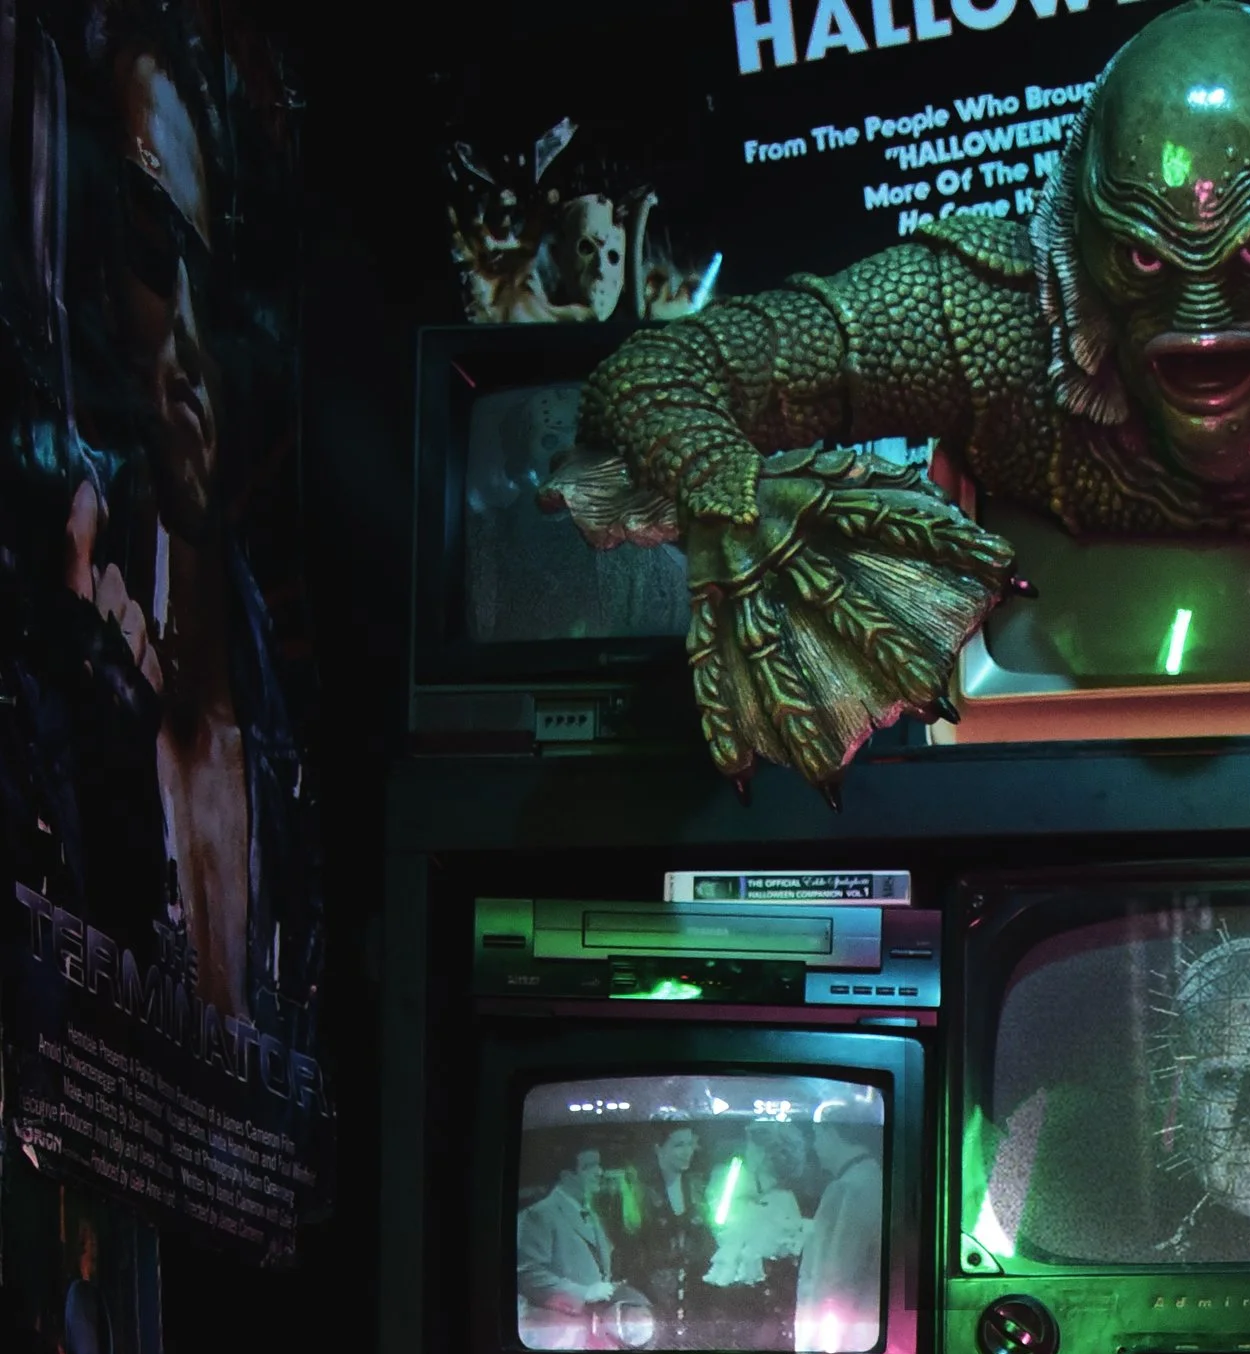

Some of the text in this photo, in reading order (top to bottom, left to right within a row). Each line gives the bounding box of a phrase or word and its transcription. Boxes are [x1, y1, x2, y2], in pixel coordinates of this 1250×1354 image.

[733, 0, 1146, 74] HALL
[743, 77, 1102, 164] From The People Who Broug
[863, 181, 931, 210] More
[936, 167, 973, 195] Of
[979, 161, 1030, 188] The
[898, 209, 934, 236] He
[748, 879, 763, 887] THE
[765, 878, 801, 888] OFFICIAL
[748, 890, 794, 899] HALLOWEEN
[796, 889, 843, 898] COMPANION
[15, 880, 331, 1118] TERMINATOR
[38, 1032, 62, 1064] Arnold
[228, 1136, 259, 1165] Hamilton
[261, 1153, 277, 1171] and
[64, 1075, 94, 1110] Make-up
[95, 1091, 118, 1122] Effects
[20, 1091, 58, 1121] ecutive
[60, 1102, 94, 1140] Producers
[124, 1141, 139, 1162] and
[223, 1112, 244, 1136] James
[245, 1120, 280, 1149] Cameron
